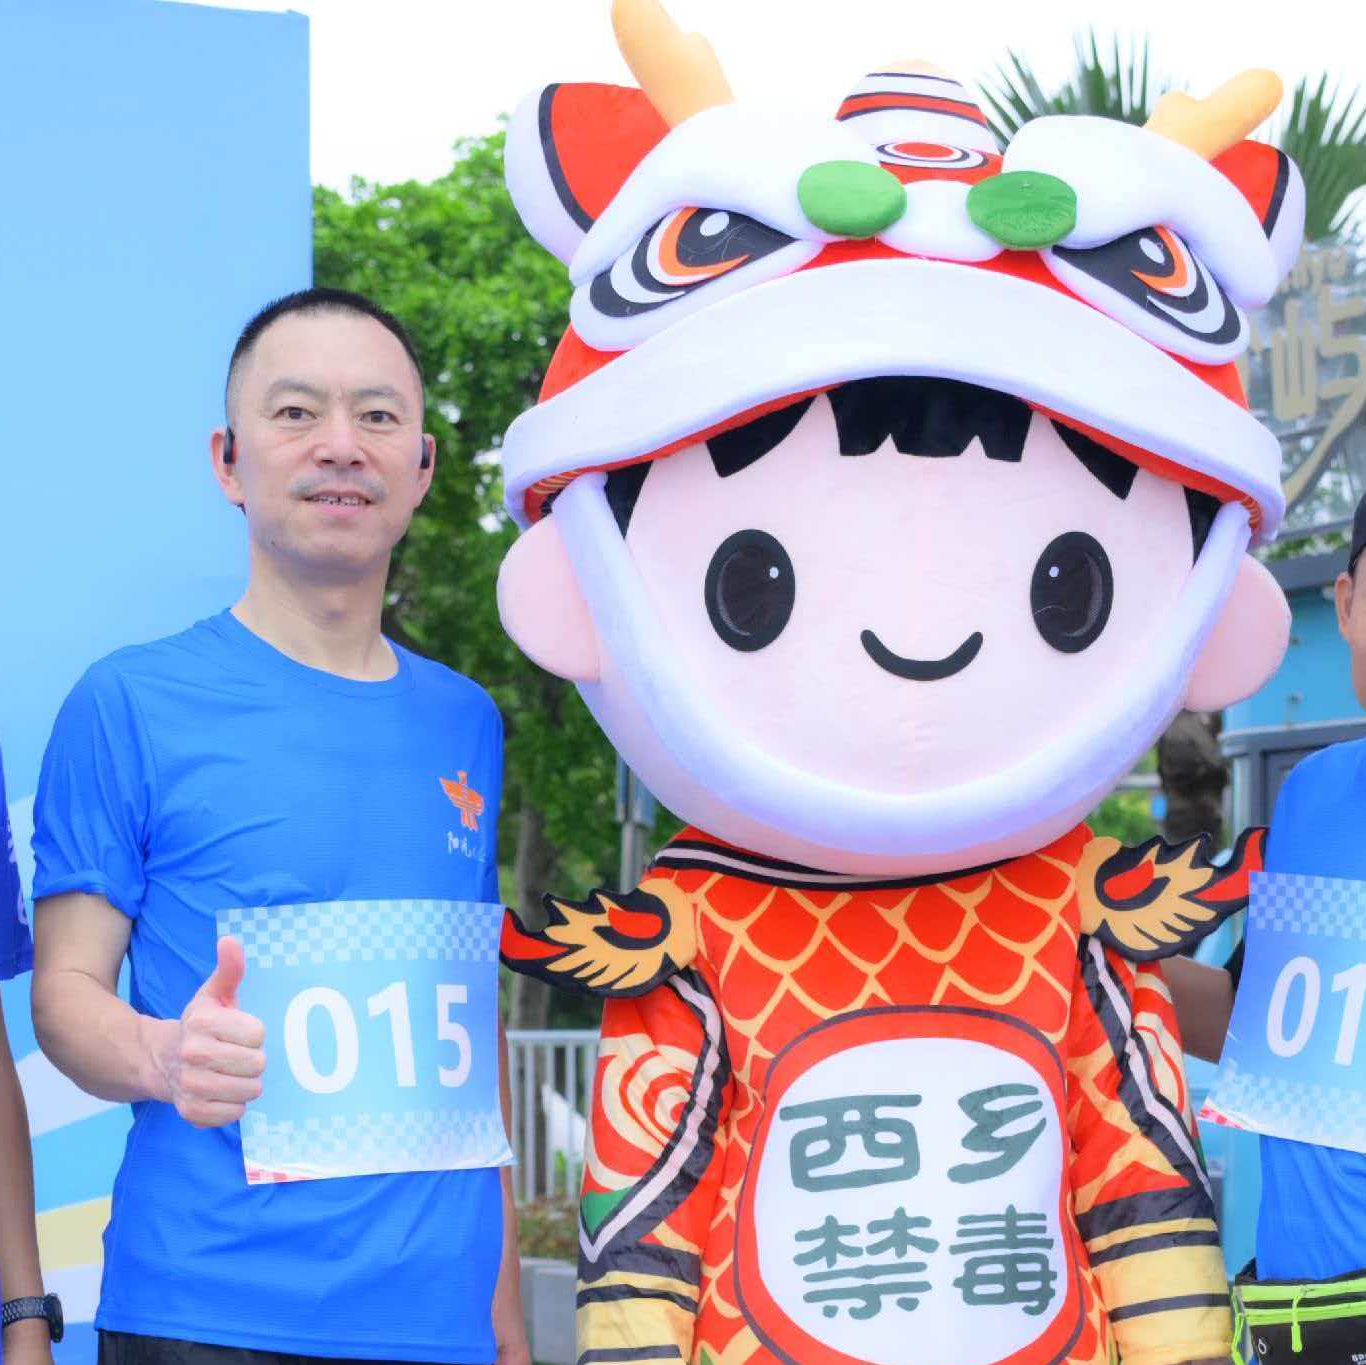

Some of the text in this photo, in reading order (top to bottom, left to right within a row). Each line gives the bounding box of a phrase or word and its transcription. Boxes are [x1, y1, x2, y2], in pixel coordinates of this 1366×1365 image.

[284, 981, 472, 1094] 015
[779, 1083, 1047, 1192] 西乡
[793, 1204, 1058, 1320] 禁毒
